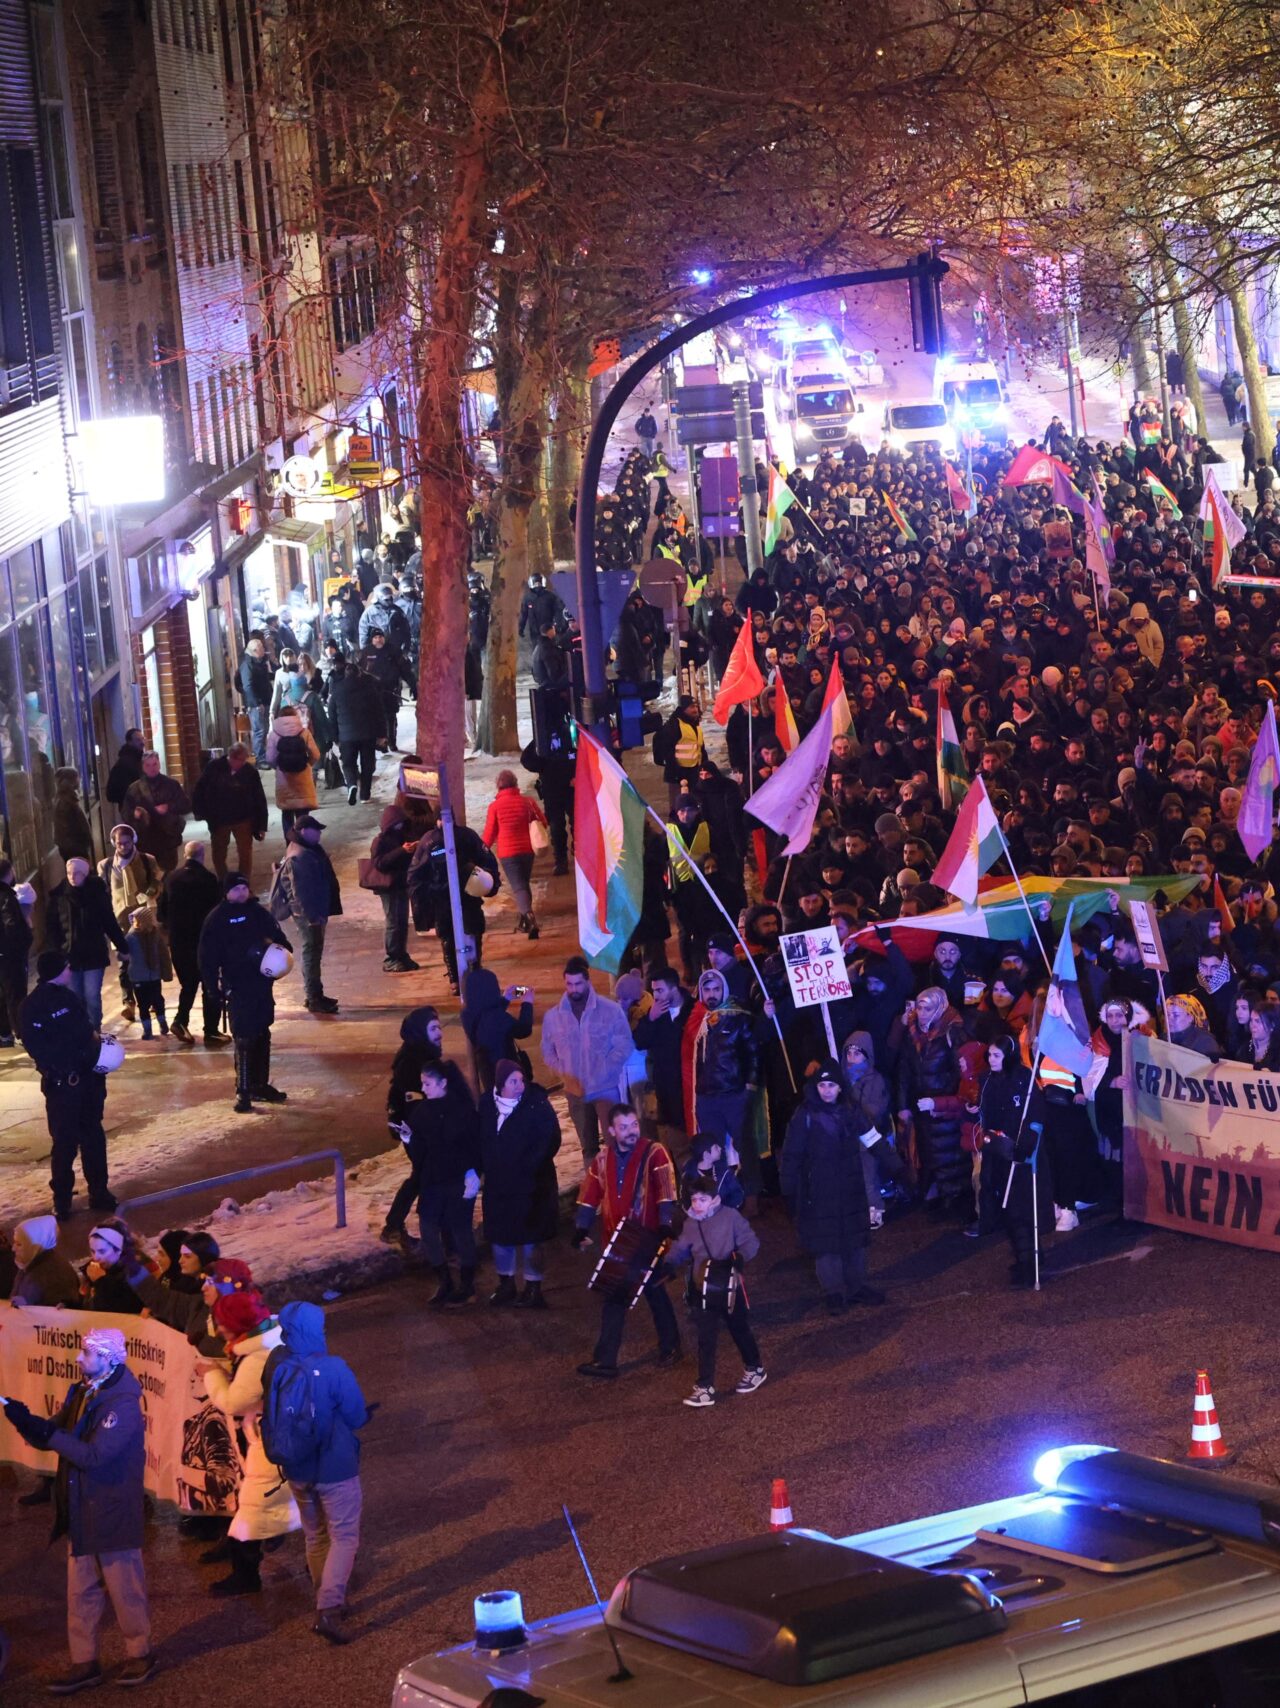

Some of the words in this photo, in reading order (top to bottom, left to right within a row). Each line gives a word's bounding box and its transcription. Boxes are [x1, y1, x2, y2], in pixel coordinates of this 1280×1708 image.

[793, 960, 834, 984] STOP
[1134, 1061, 1239, 1109] FRIEDEN
[1160, 1159, 1263, 1232] NEIN
[27, 1357, 44, 1376] und
[125, 1337, 166, 1371] riffskrieg
